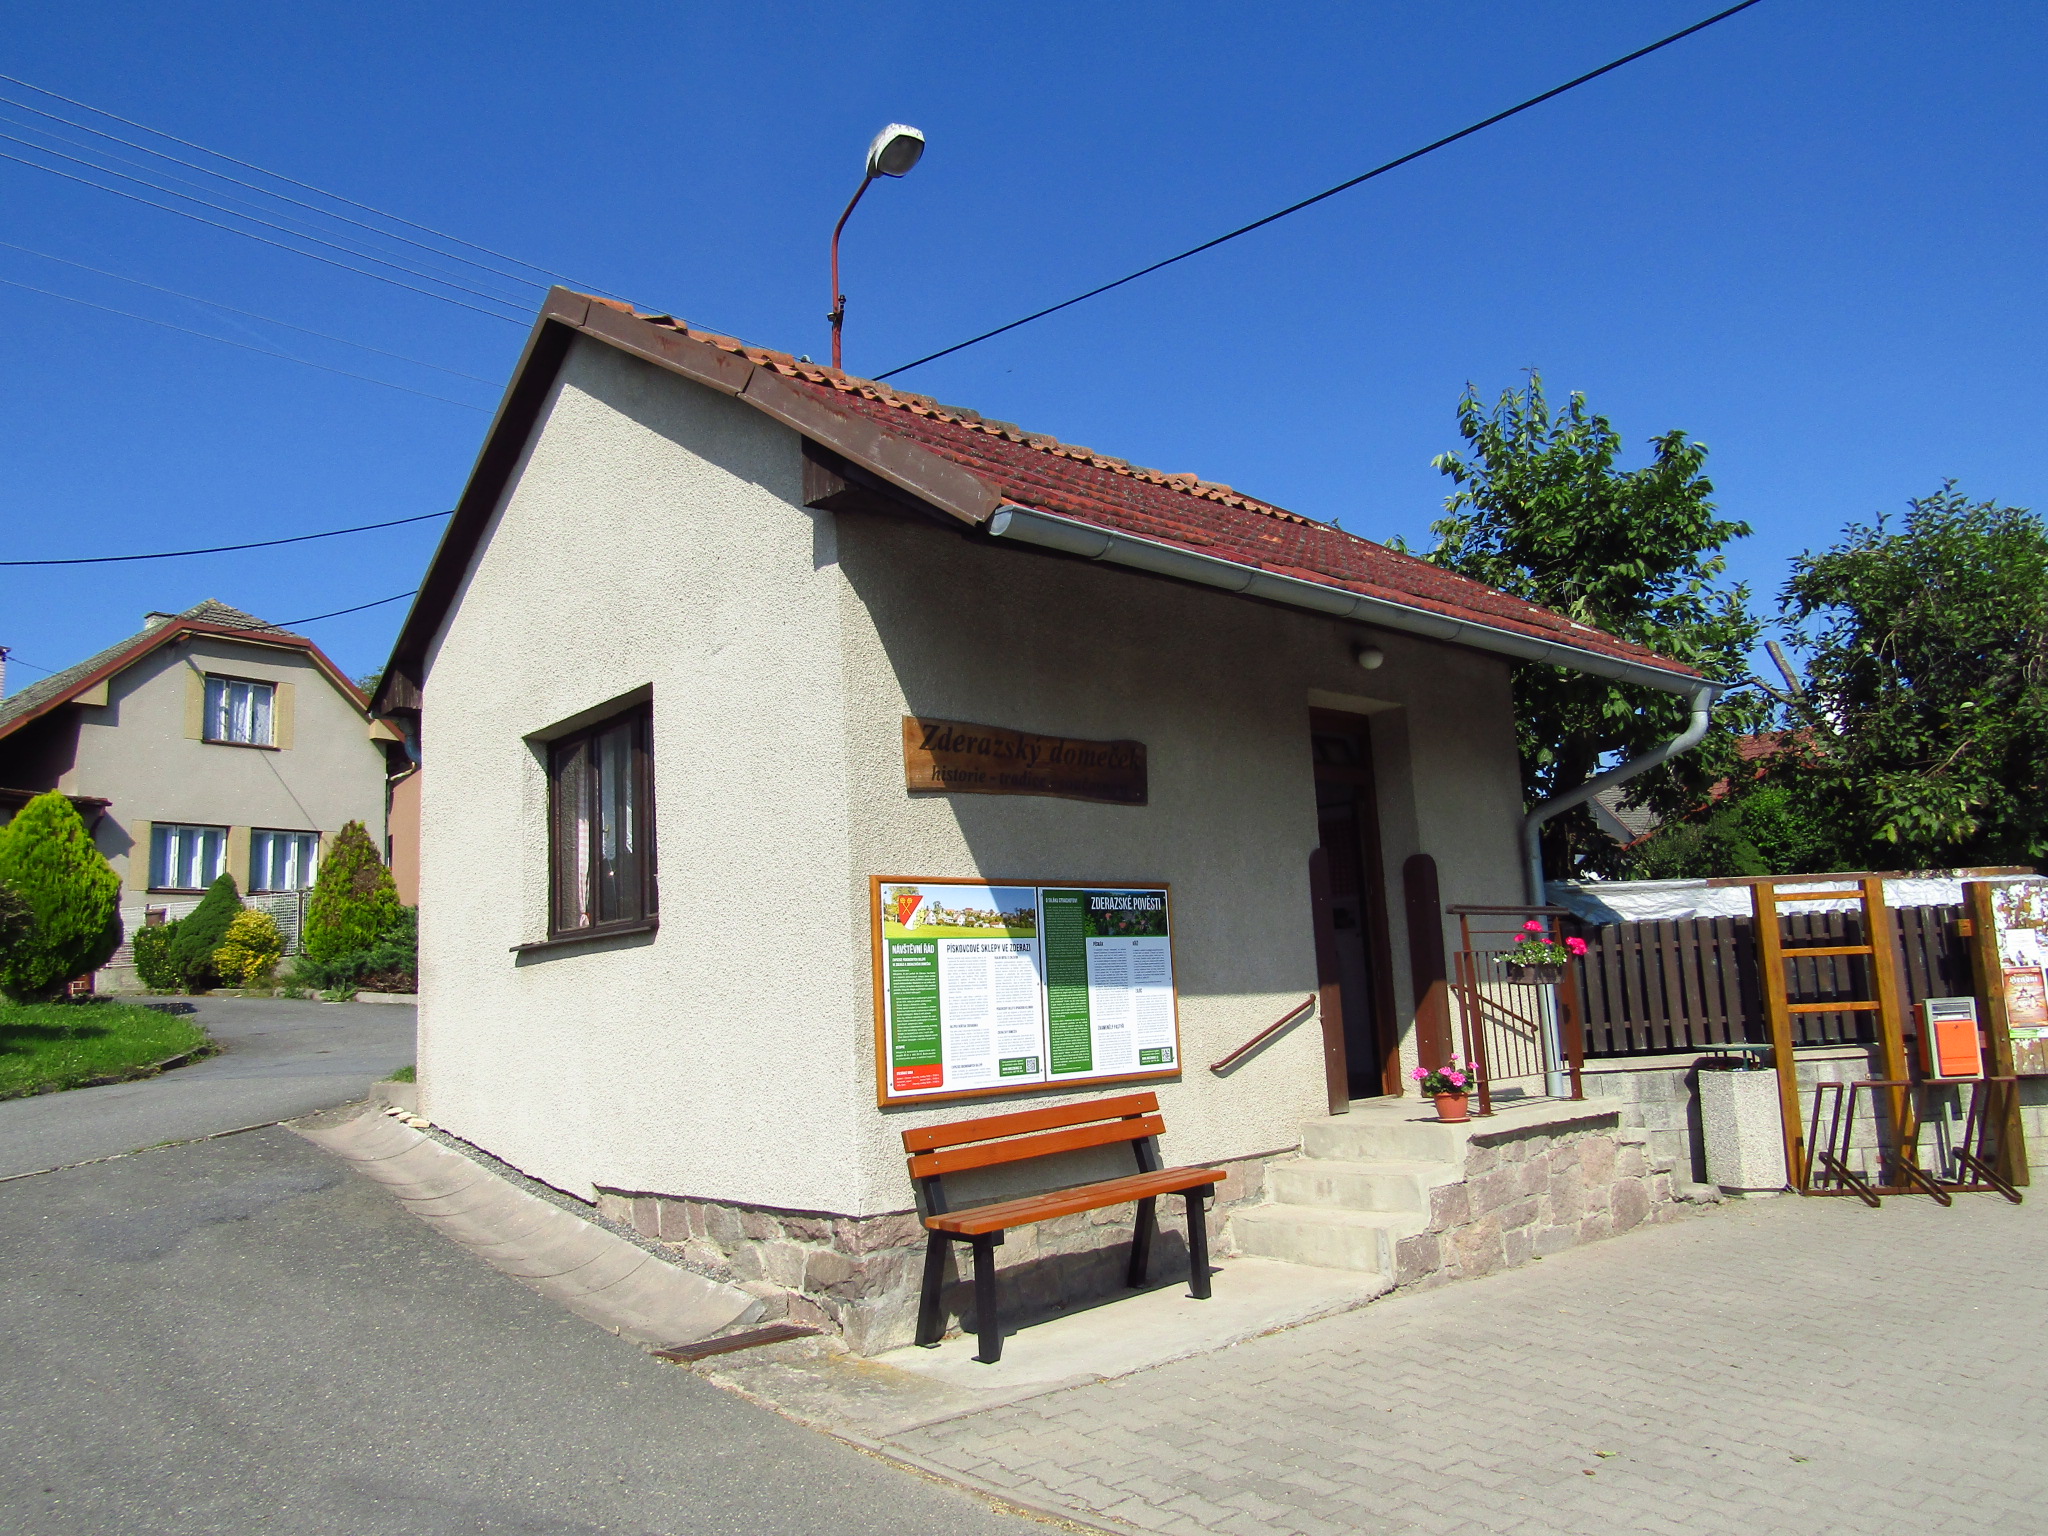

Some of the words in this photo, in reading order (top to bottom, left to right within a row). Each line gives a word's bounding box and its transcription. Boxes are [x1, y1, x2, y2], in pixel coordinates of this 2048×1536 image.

[1049, 742, 1141, 771] domeček
[931, 765, 986, 783] historie
[1091, 895, 1131, 910] ZDERAZSKÉ
[1133, 895, 1161, 911] POVĚSTI
[892, 943, 923, 954] NÁVŠTĚVNÍ
[923, 943, 935, 954] ŘÁD
[946, 943, 979, 953] PÍSKOVCOVÉ
[981, 943, 1000, 953] SKLEPY
[1002, 943, 1008, 952] VE
[1009, 943, 1031, 952] ZDERAZI
